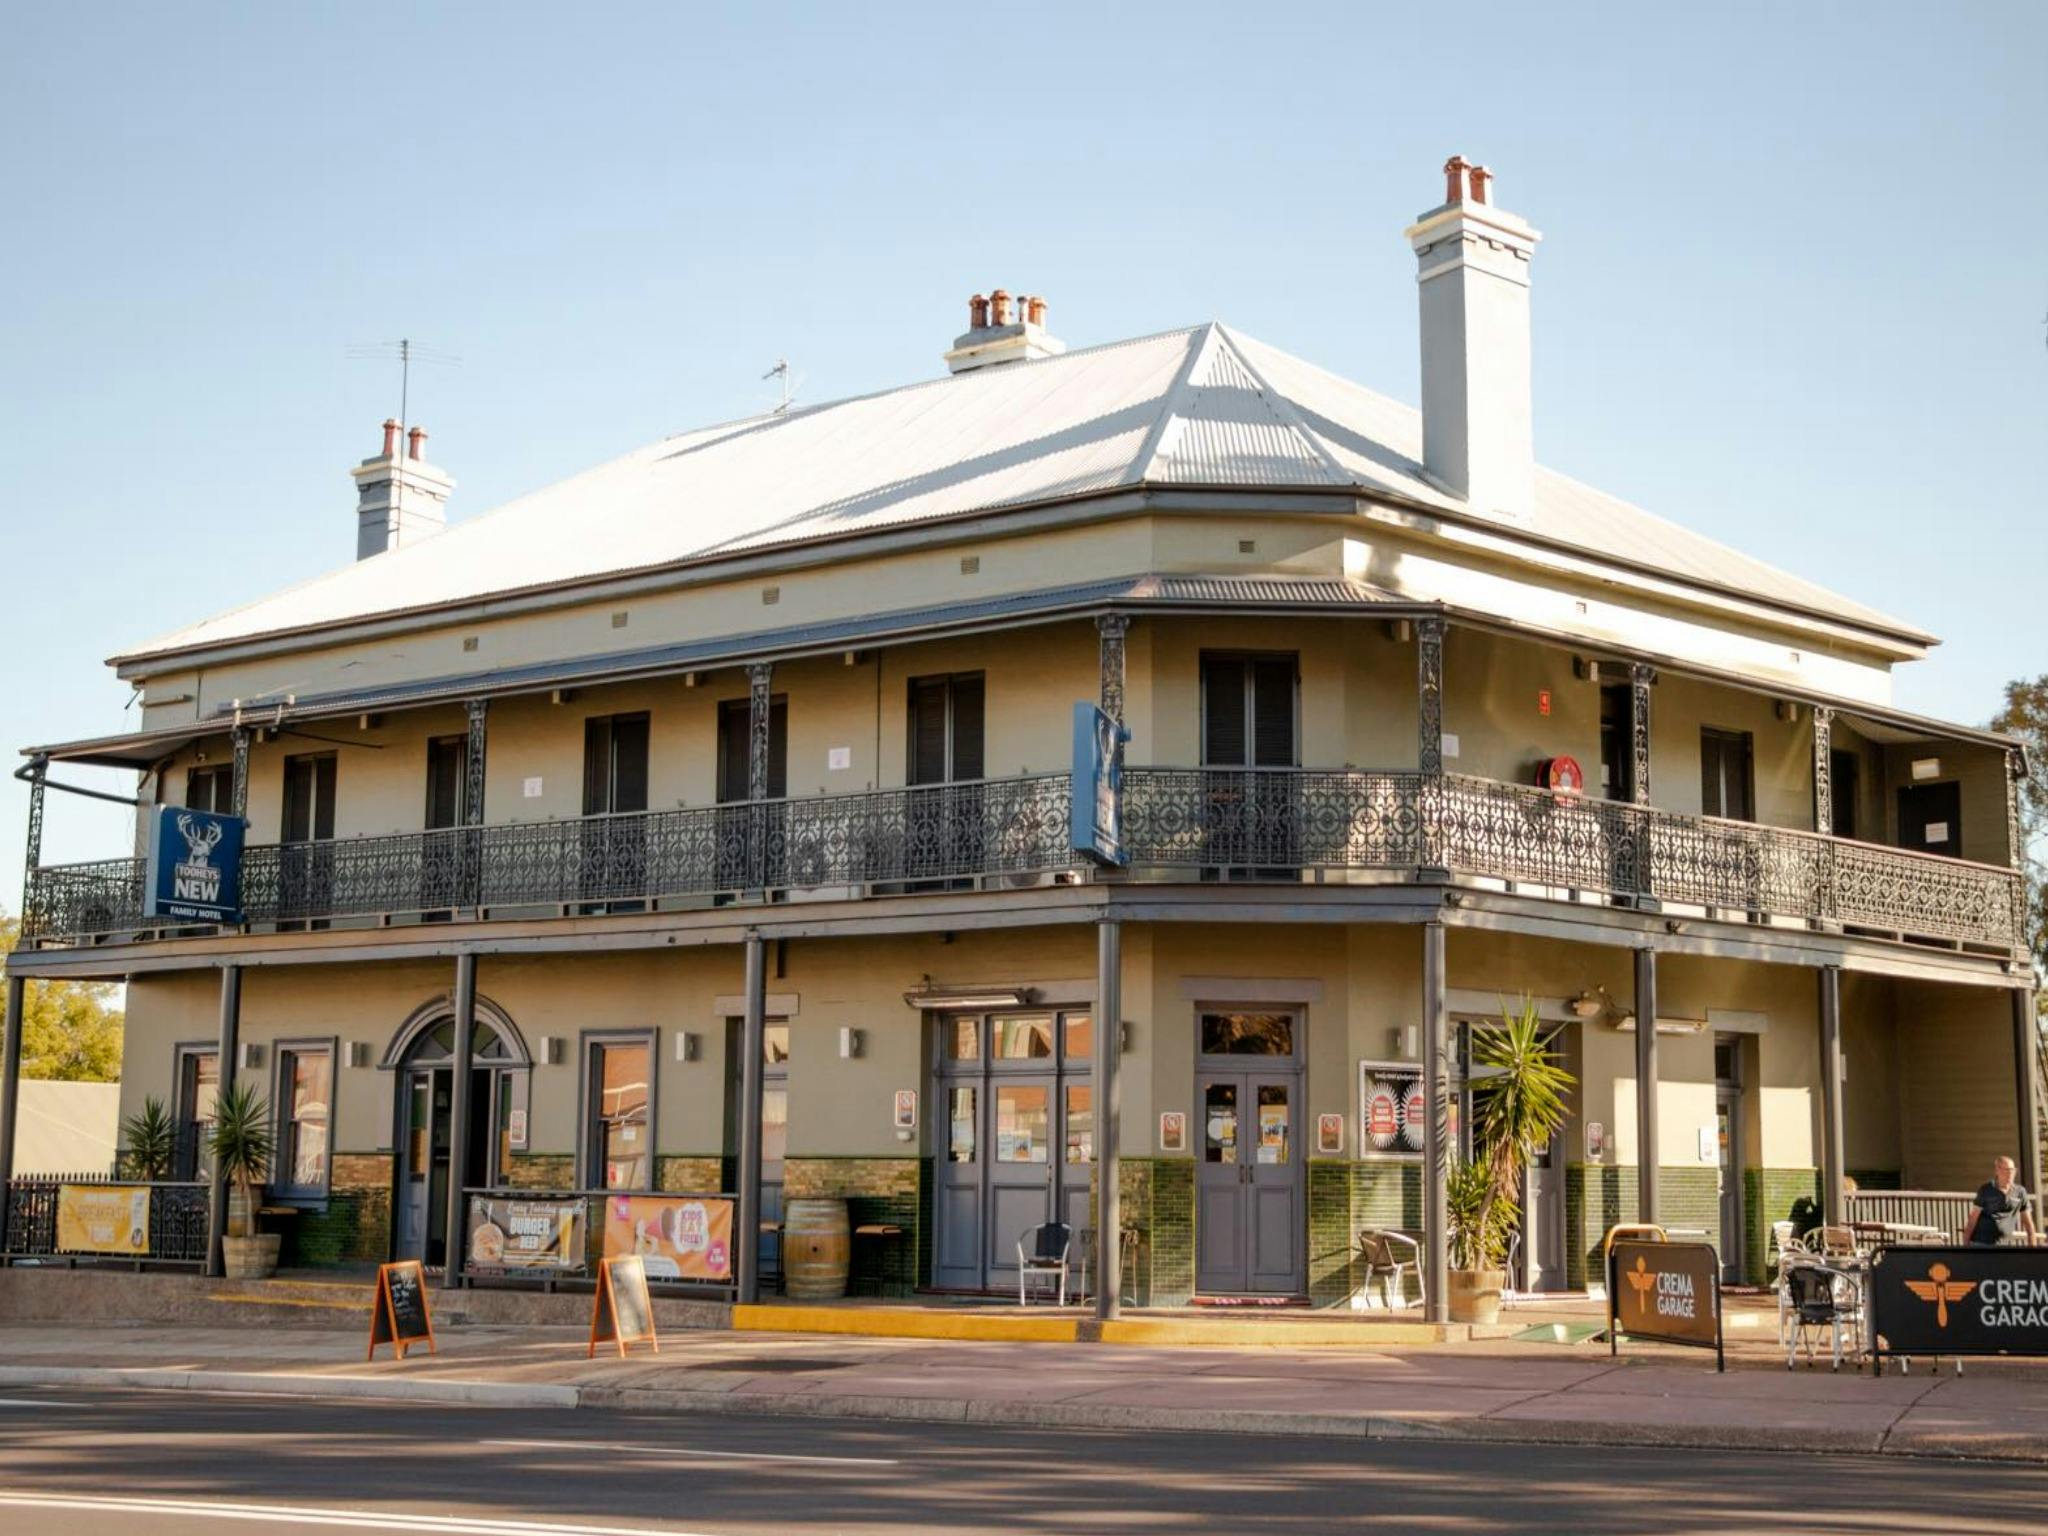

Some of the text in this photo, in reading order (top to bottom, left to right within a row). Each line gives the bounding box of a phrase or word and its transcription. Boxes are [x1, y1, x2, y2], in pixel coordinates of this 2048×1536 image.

[178, 866, 218, 880] TOOHEYS
[174, 879, 219, 902] NEW
[170, 905, 222, 920] FAMILY HOTEL
[509, 1216, 551, 1235] BURGER
[1656, 1271, 1695, 1297] CREMA
[1656, 1295, 1696, 1318] GARAGE
